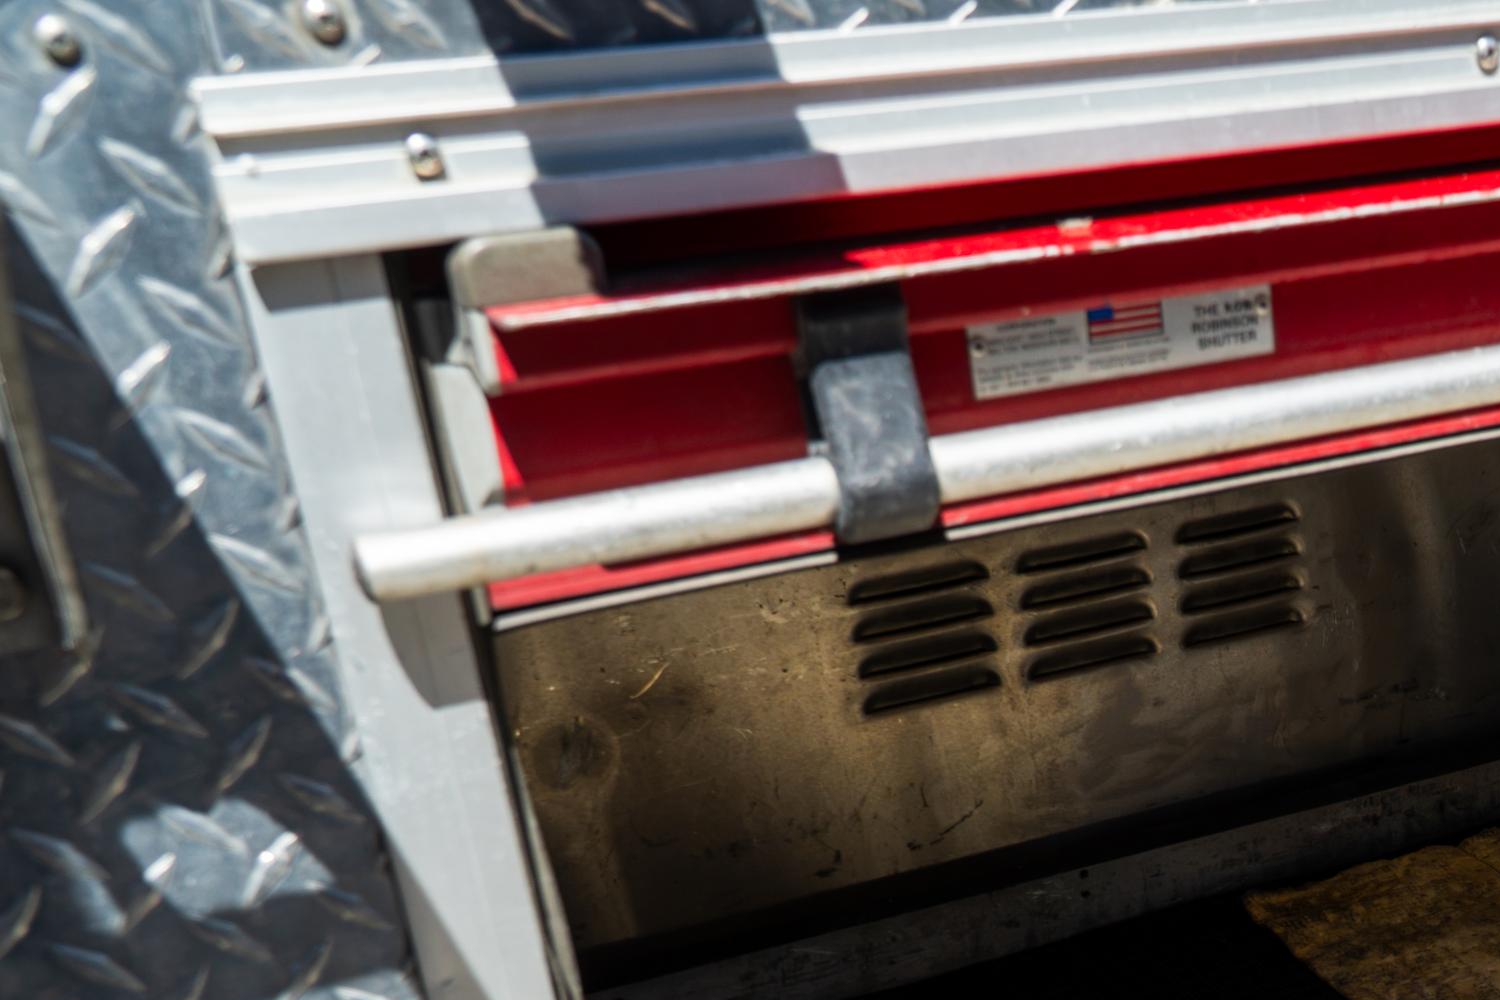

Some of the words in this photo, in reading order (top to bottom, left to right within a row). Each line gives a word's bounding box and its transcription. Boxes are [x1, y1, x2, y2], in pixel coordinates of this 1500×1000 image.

[1193, 304, 1218, 317] THE
[1191, 314, 1258, 334] ROBINSON
[1198, 329, 1256, 350] SHUTTER
